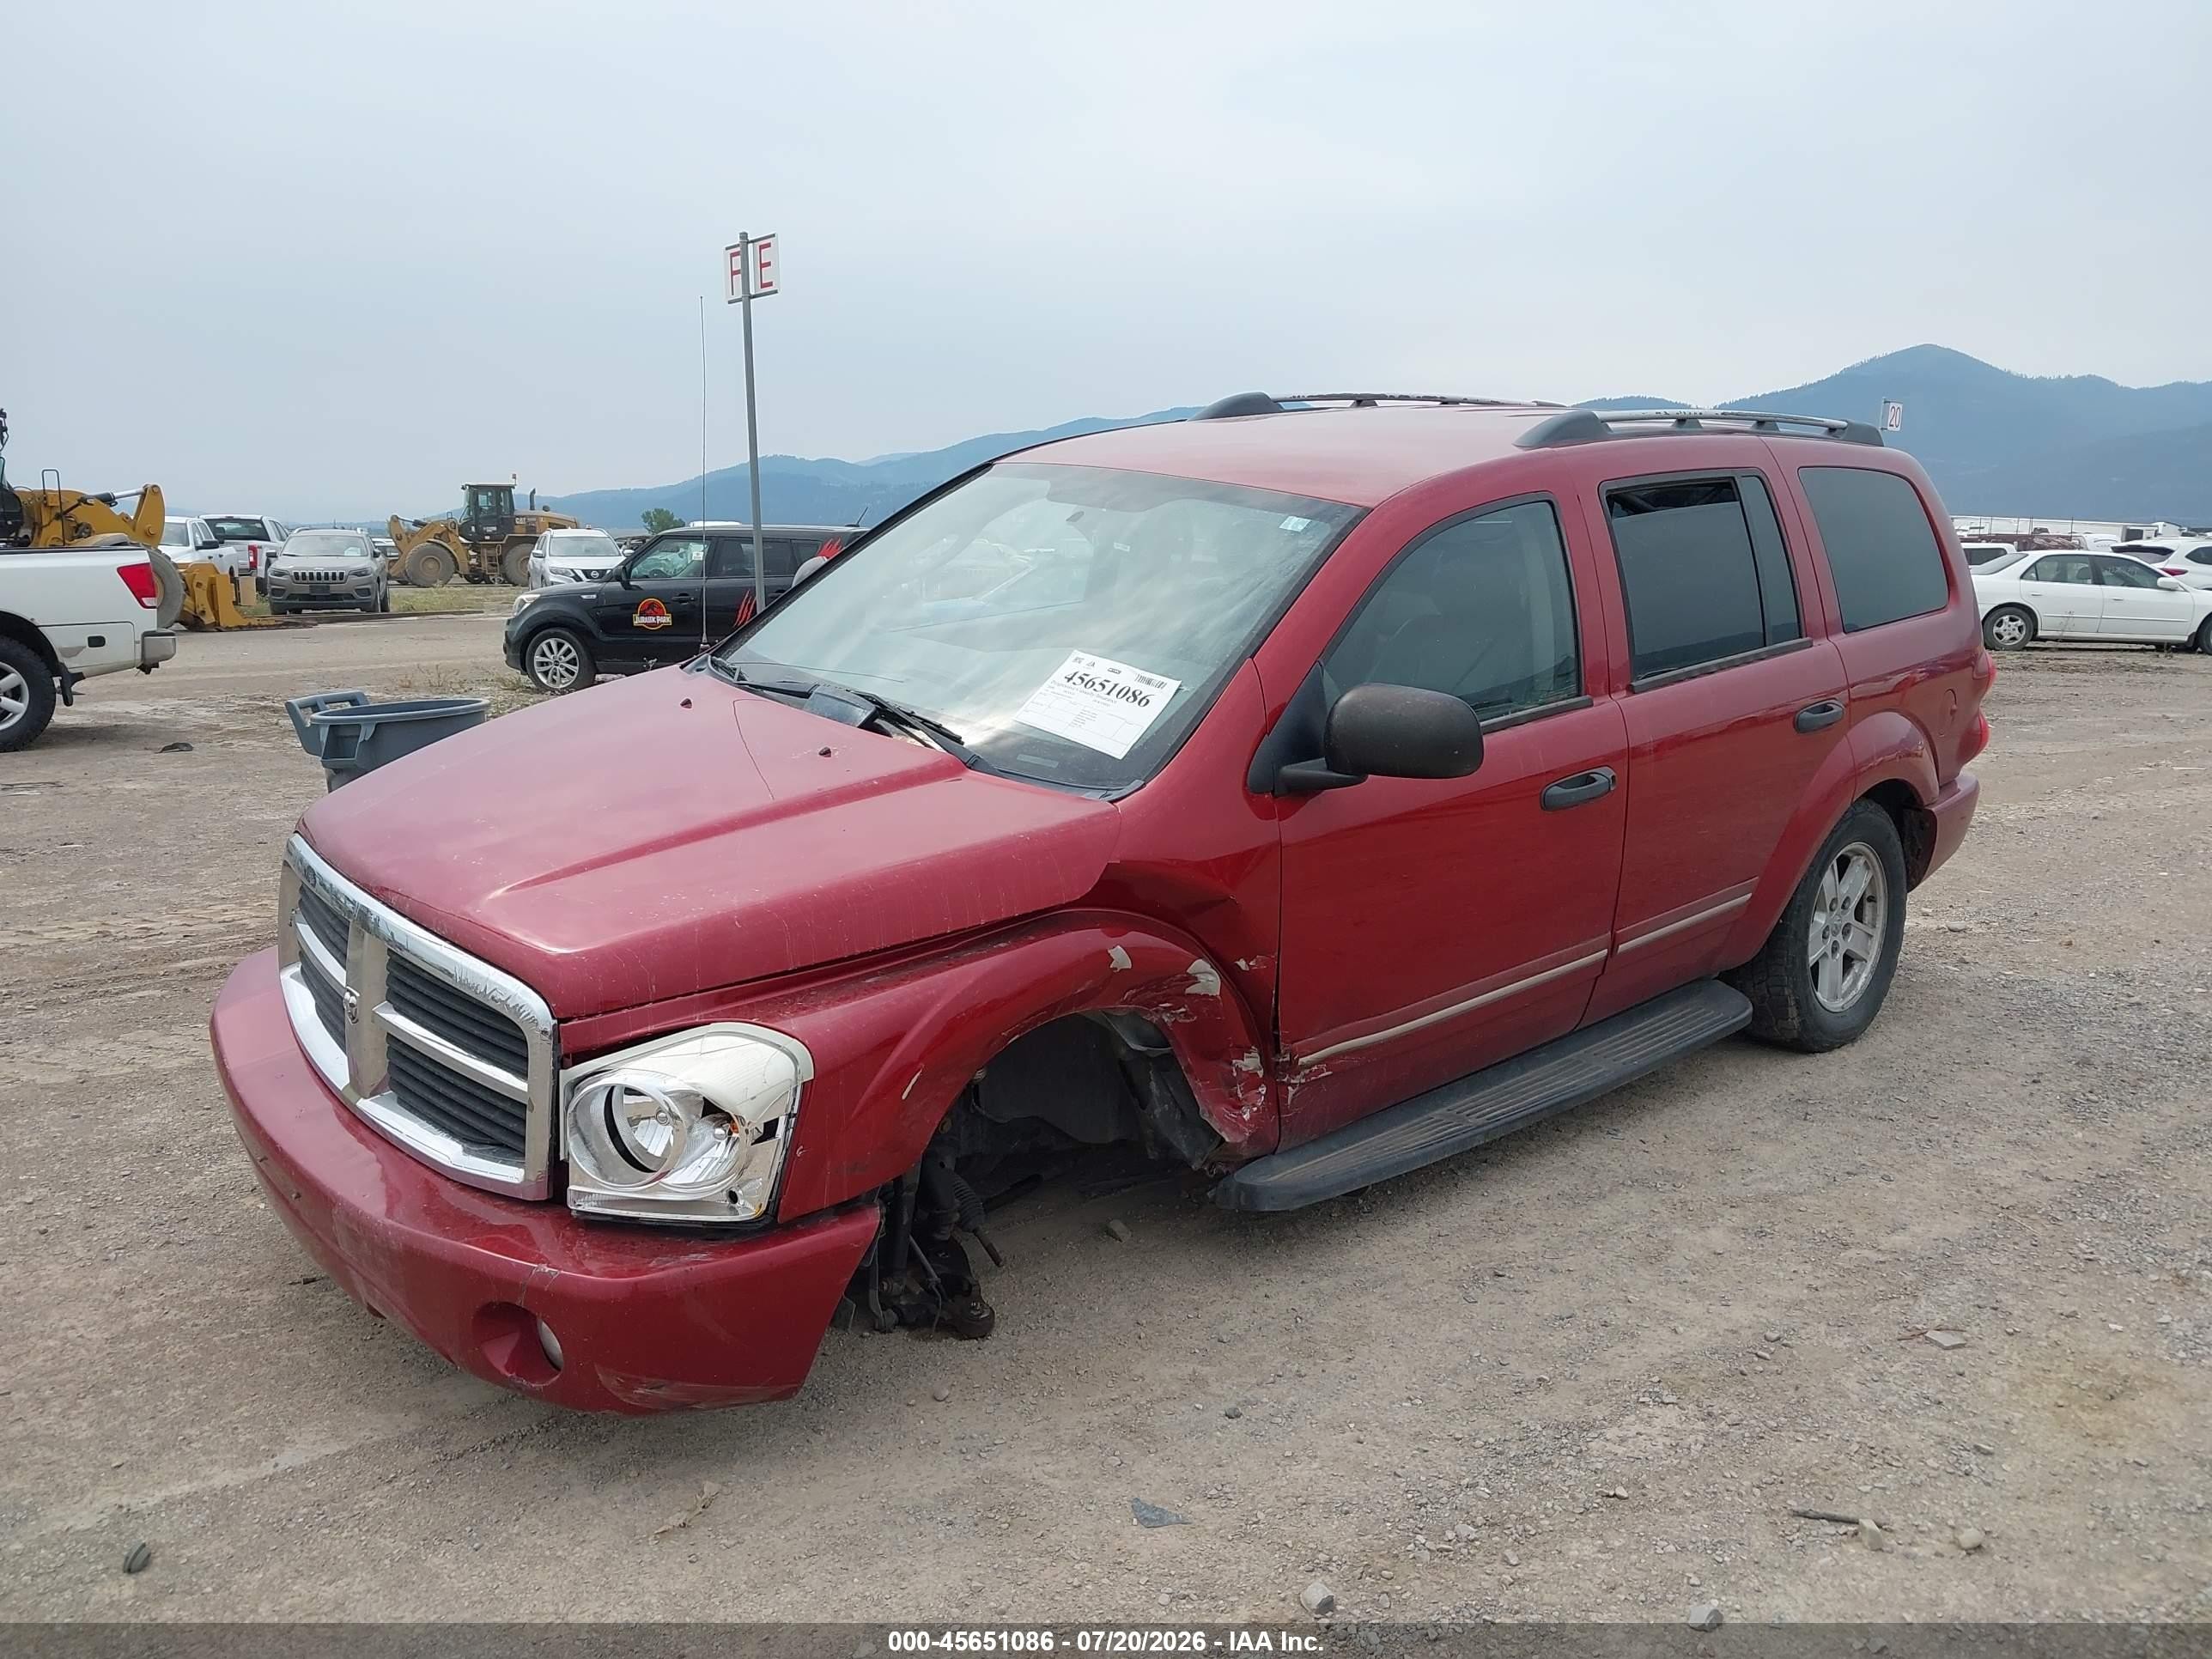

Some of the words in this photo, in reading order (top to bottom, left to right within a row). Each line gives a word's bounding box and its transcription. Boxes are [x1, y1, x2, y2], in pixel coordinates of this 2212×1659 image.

[759, 242, 774, 289] E
[1888, 405, 1901, 428] 20
[1064, 671, 1155, 708] 45651086
